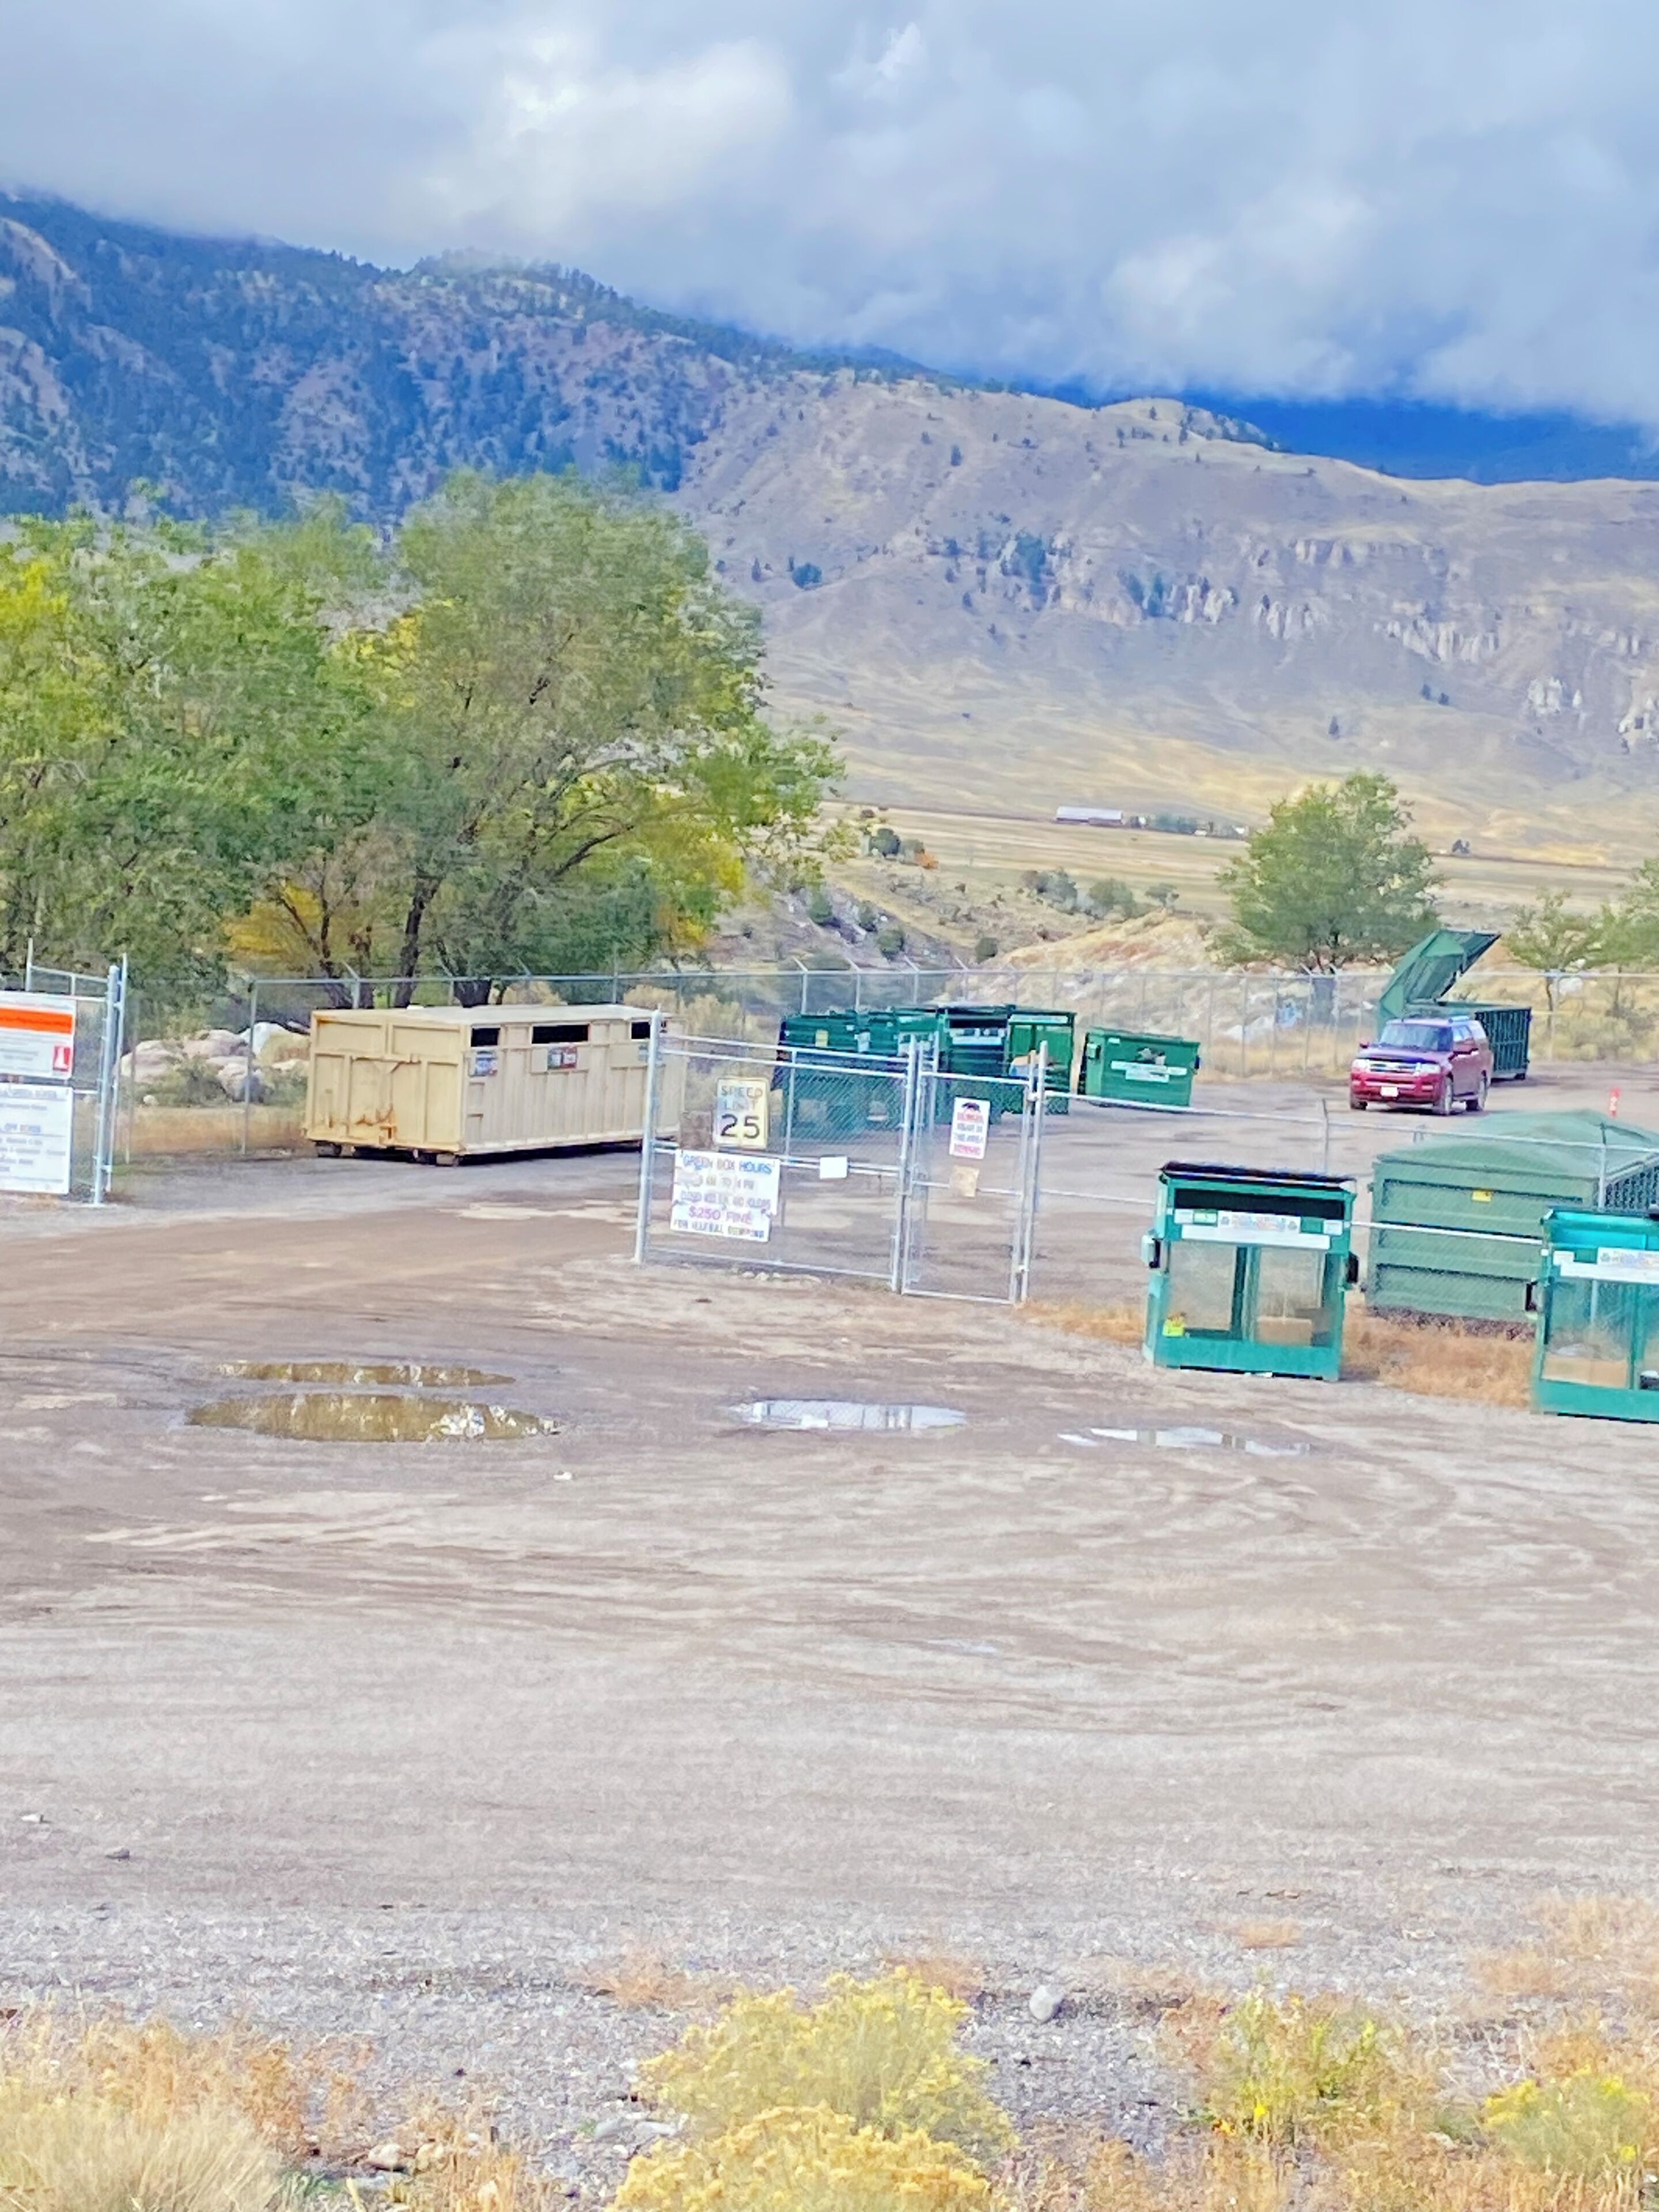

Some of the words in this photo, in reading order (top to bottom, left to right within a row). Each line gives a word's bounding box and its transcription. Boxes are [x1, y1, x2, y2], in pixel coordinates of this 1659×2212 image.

[721, 1085, 763, 1098] SPEED
[721, 1113, 760, 1139] 25
[738, 1160, 772, 1175] HOURS
[688, 1206, 721, 1220] $250
